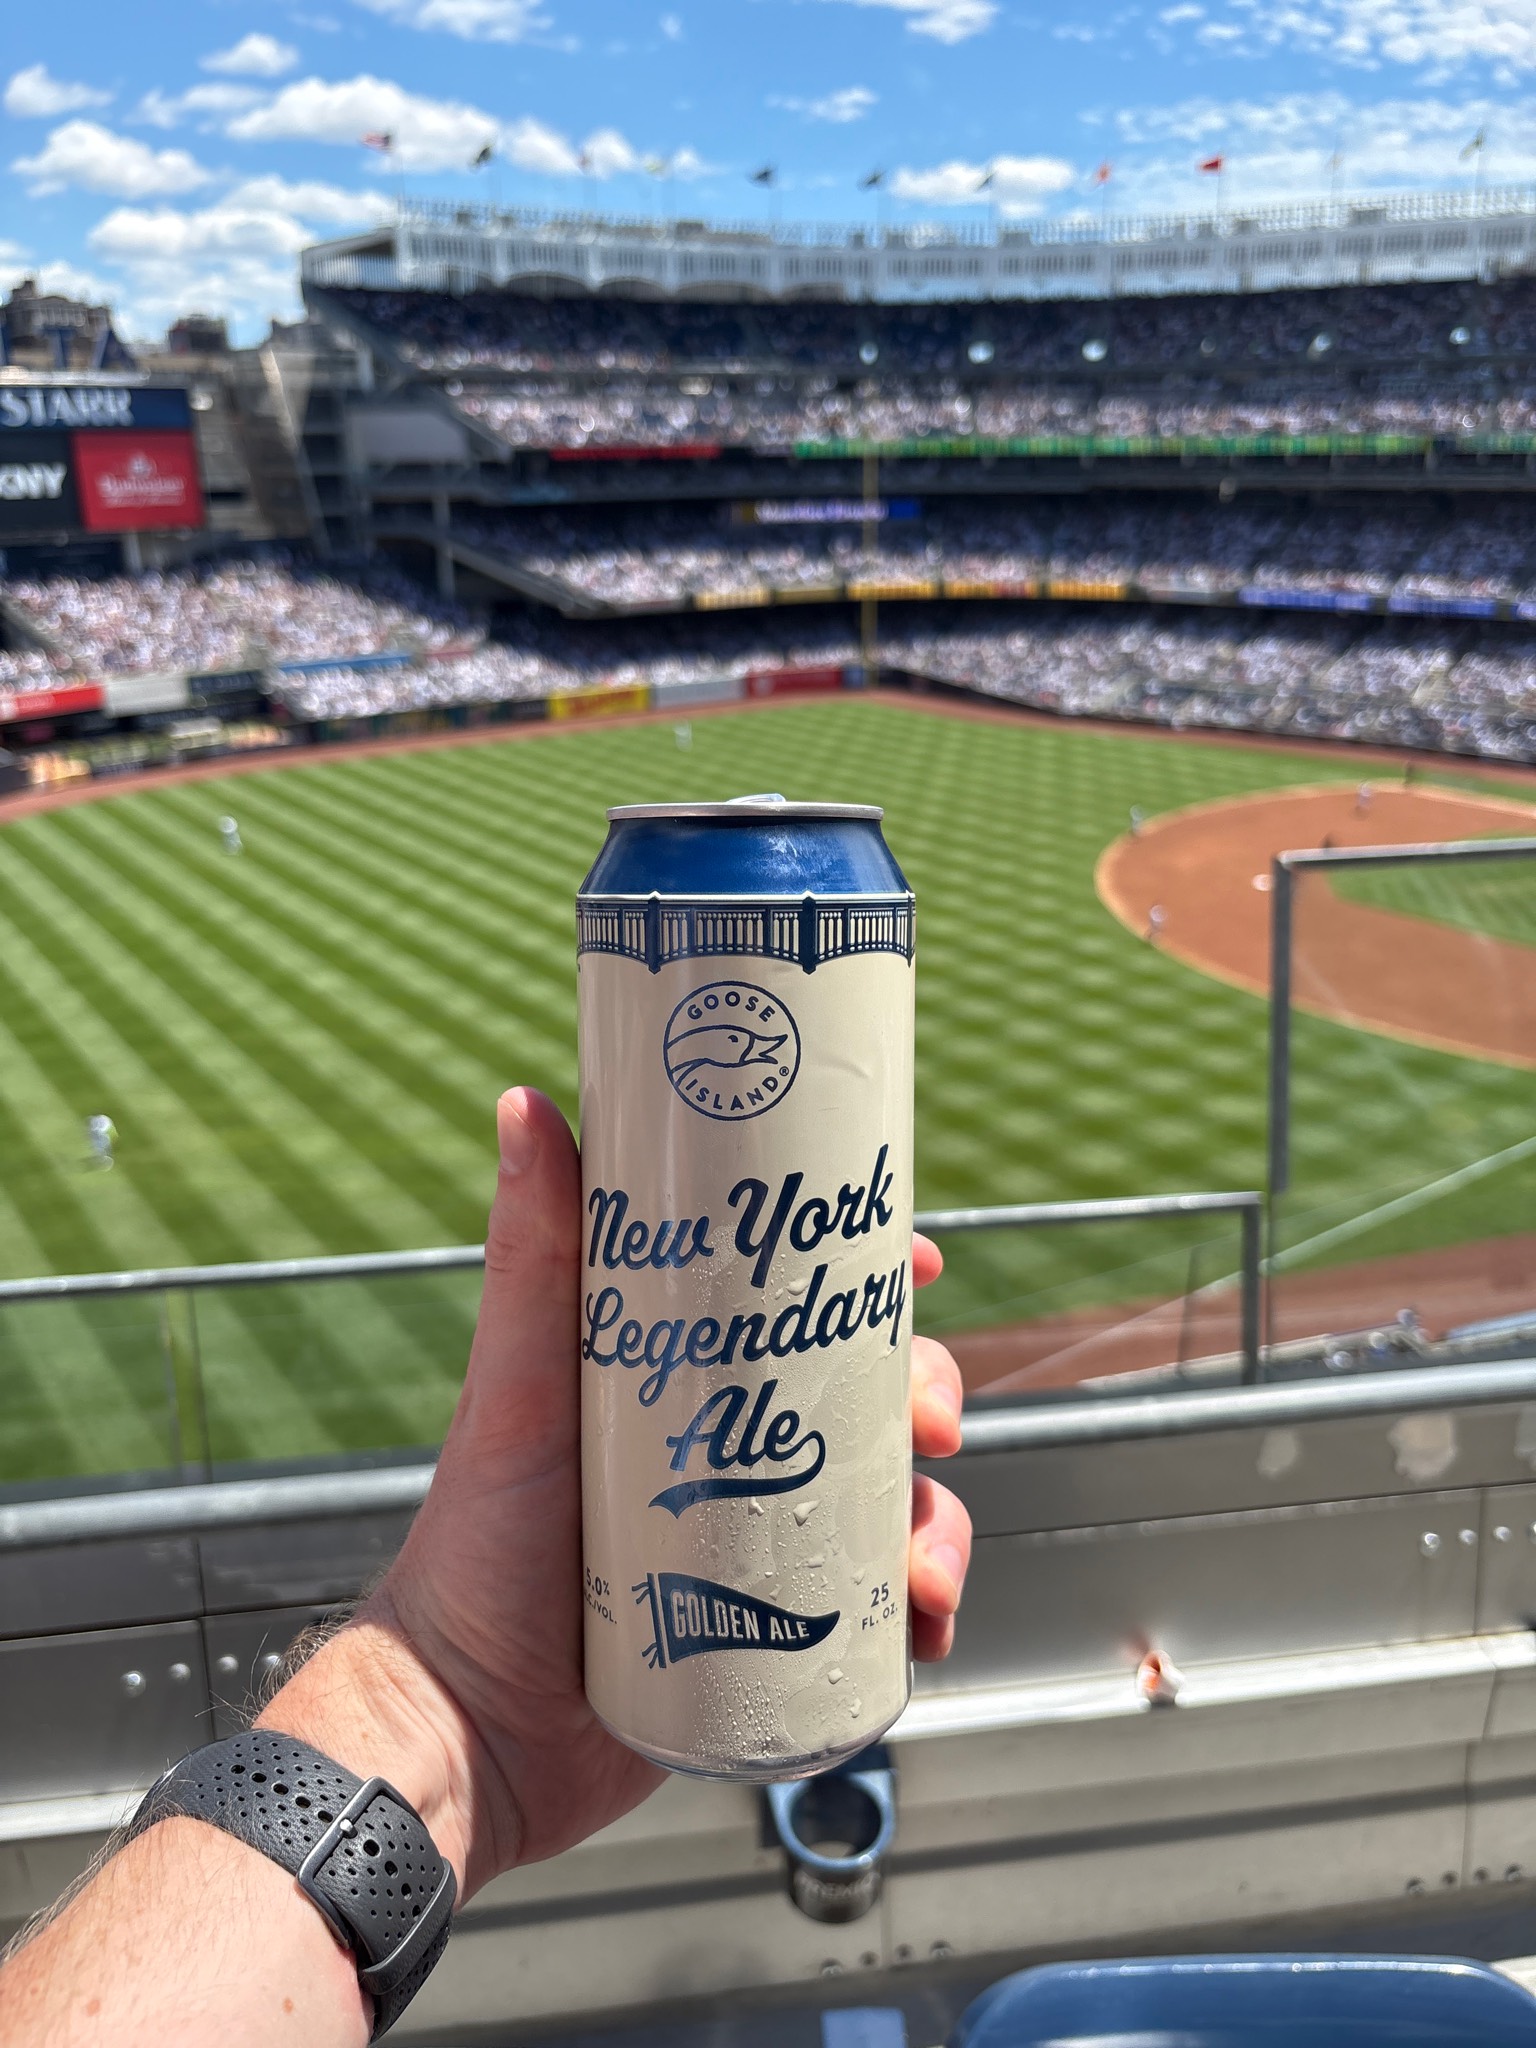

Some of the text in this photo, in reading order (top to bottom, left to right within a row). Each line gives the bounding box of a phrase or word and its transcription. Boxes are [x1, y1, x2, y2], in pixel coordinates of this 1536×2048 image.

[687, 990, 776, 1023] GOOSE
[587, 1143, 894, 1289] New York
[582, 1260, 907, 1408] Legendary
[665, 1379, 826, 1472] Ale
[585, 1566, 610, 1596] 5.0%
[870, 1581, 889, 1608] 25
[669, 1588, 810, 1641] GOLDEN ALE
[861, 1602, 898, 1631] FL. OZ.
